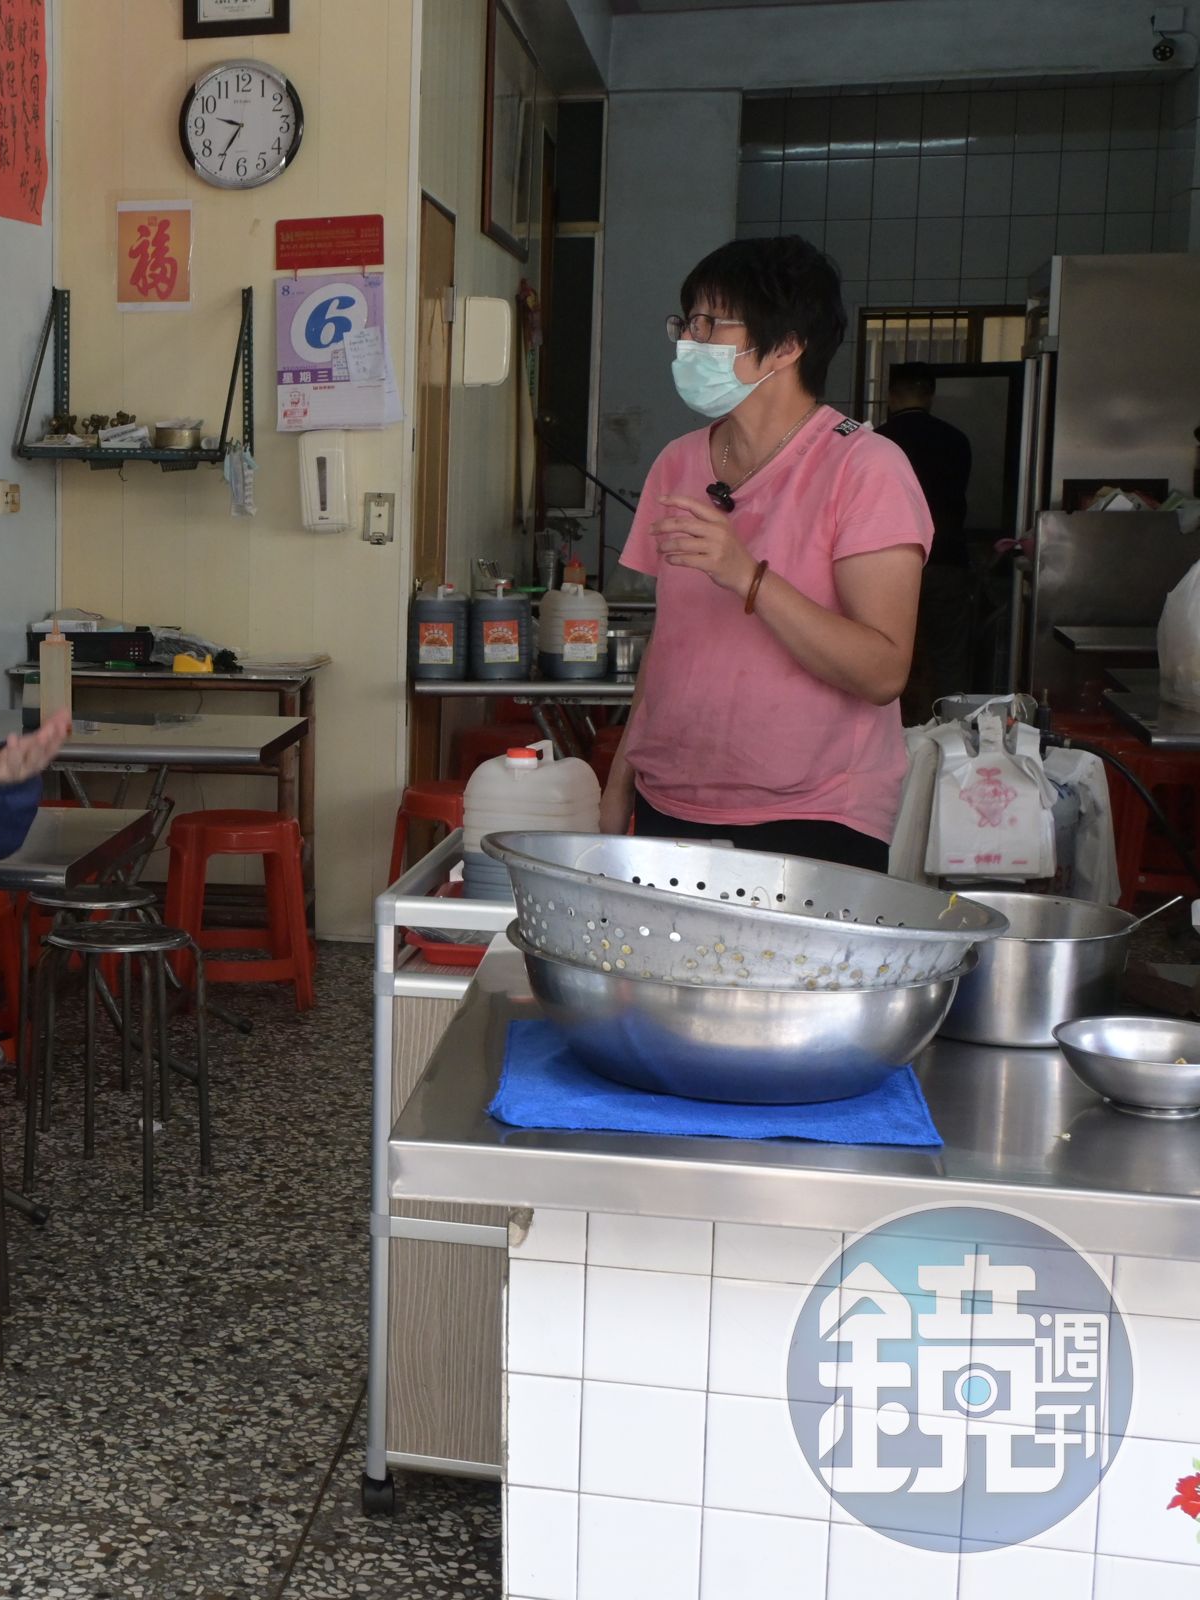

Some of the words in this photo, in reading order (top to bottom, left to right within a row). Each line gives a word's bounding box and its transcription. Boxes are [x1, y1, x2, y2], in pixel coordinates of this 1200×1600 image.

[217, 80, 229, 99] 11
[236, 73, 252, 93] 12
[260, 79, 265, 98] 1
[201, 95, 217, 114] 10
[272, 92, 283, 112] 2
[194, 116, 205, 136] 9
[279, 114, 290, 134] 3
[201, 138, 213, 158] 8
[271, 137, 282, 155] 4
[217, 153, 227, 171] 7
[236, 157, 247, 177] 6
[255, 152, 267, 170] 5
[128, 219, 178, 300] 福
[281, 285, 290, 296] 8
[305, 295, 356, 349] 6
[281, 370, 329, 384] 星期三
